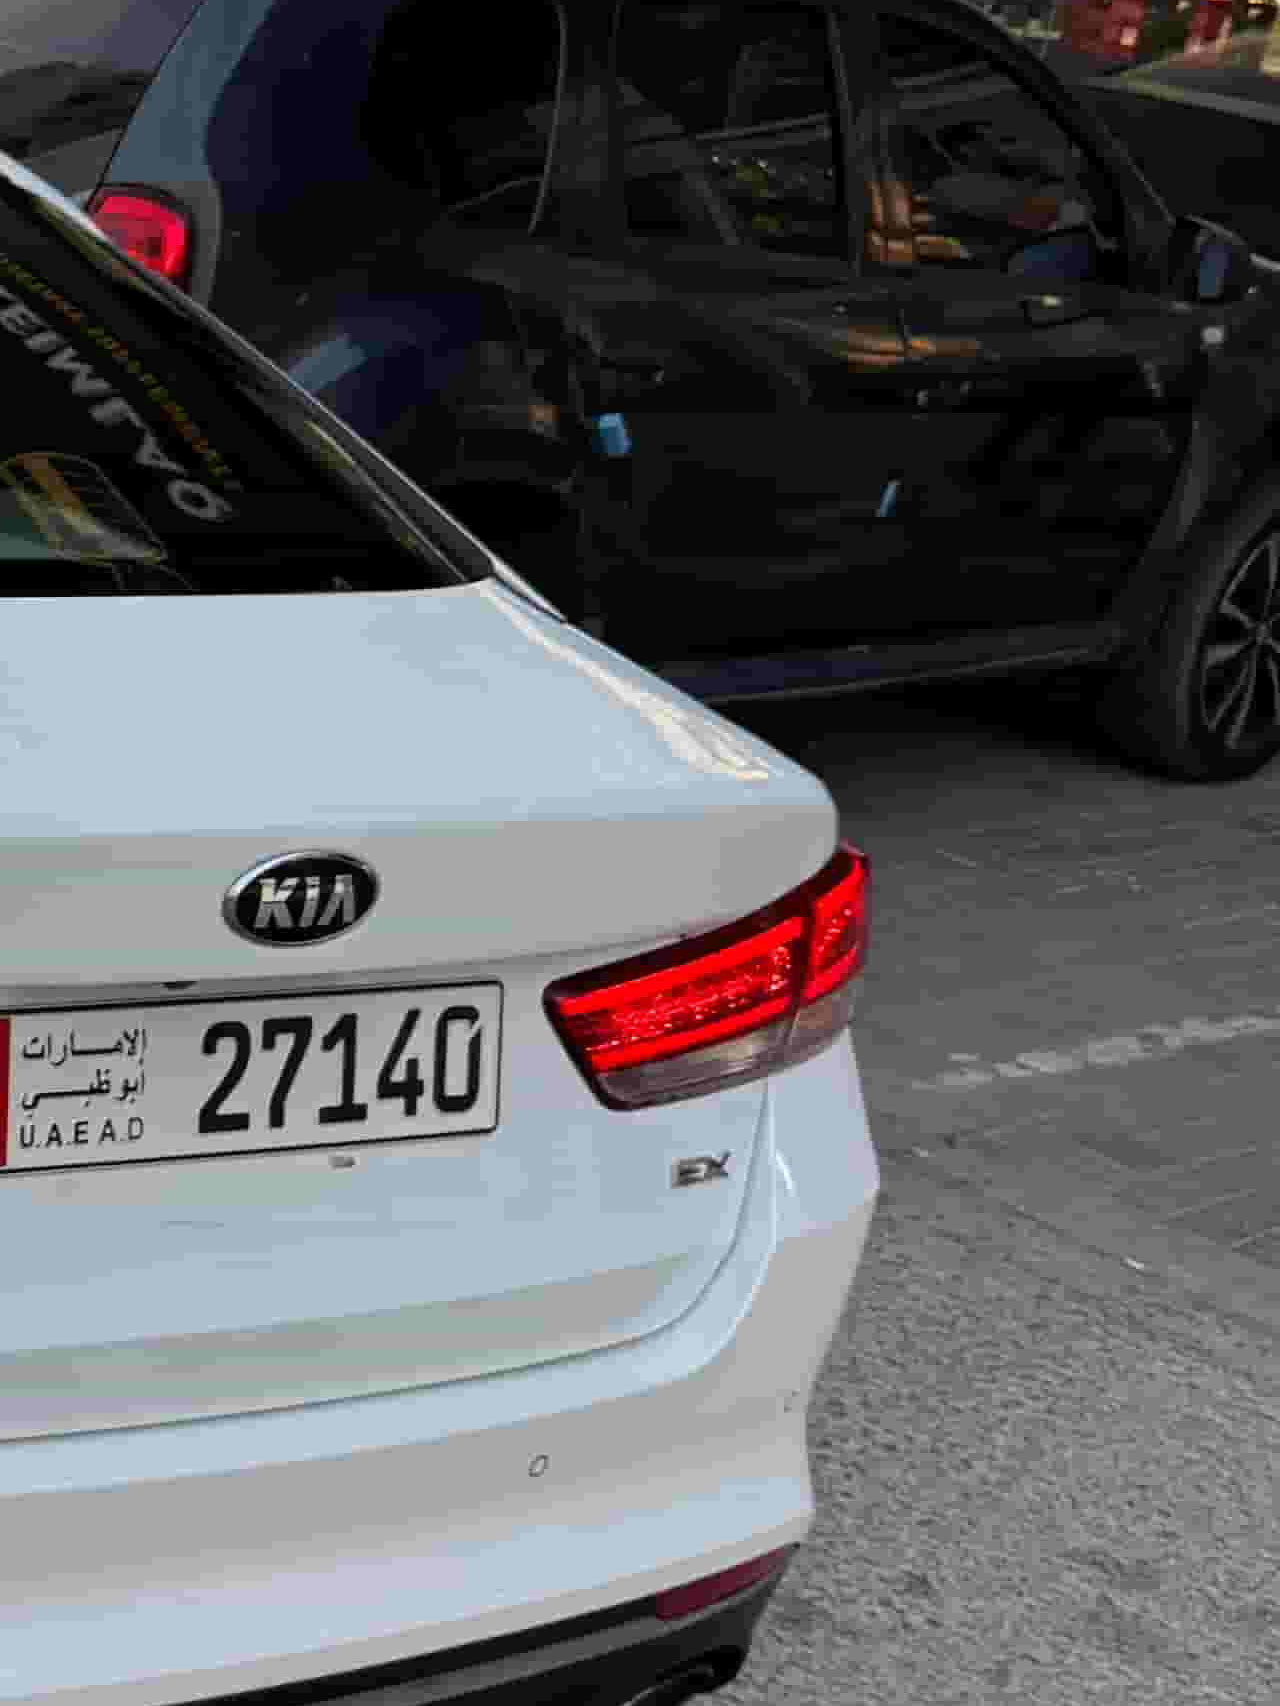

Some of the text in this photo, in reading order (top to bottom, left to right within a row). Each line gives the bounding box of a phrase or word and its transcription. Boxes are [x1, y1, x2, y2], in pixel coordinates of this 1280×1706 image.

[254, 872, 358, 929] KIA
[198, 1005, 483, 1134] 27140
[671, 1151, 730, 1189] EX
